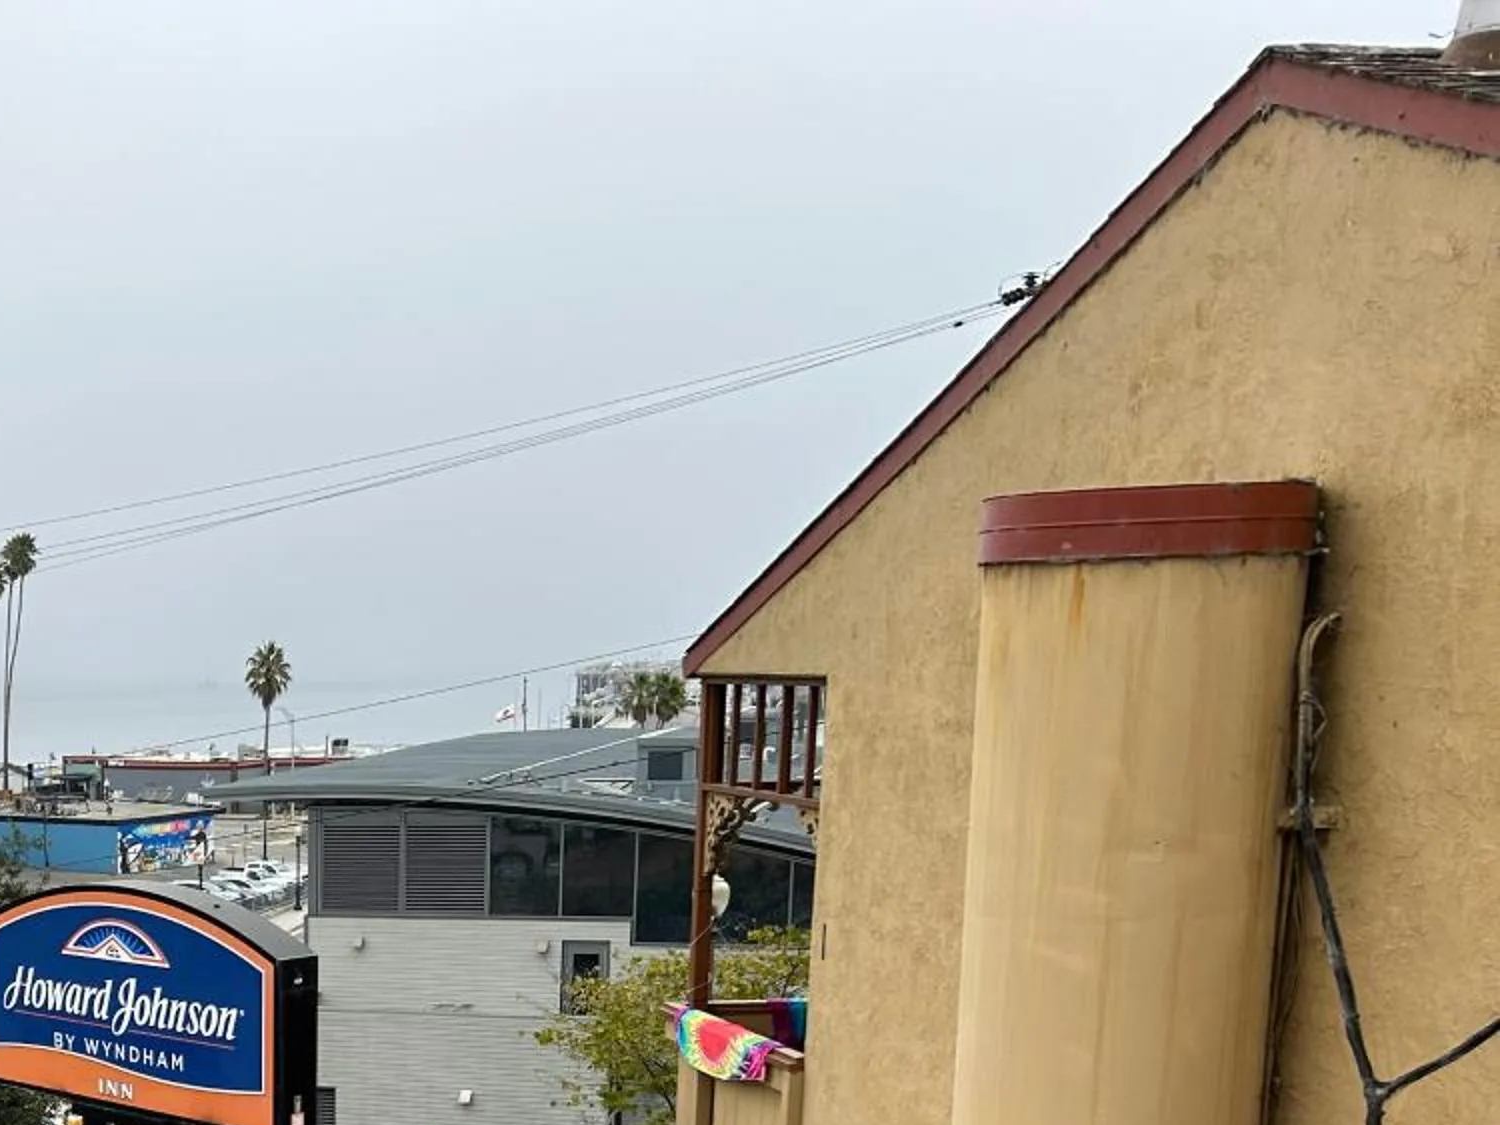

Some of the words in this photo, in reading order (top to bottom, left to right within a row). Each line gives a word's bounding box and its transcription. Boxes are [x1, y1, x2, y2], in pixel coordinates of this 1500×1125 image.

[3, 965, 111, 1022] Howard
[111, 978, 238, 1042] Johnson
[53, 1031, 76, 1052] BY
[83, 1037, 185, 1073] WYNDHAM
[98, 1078, 134, 1101] INN
